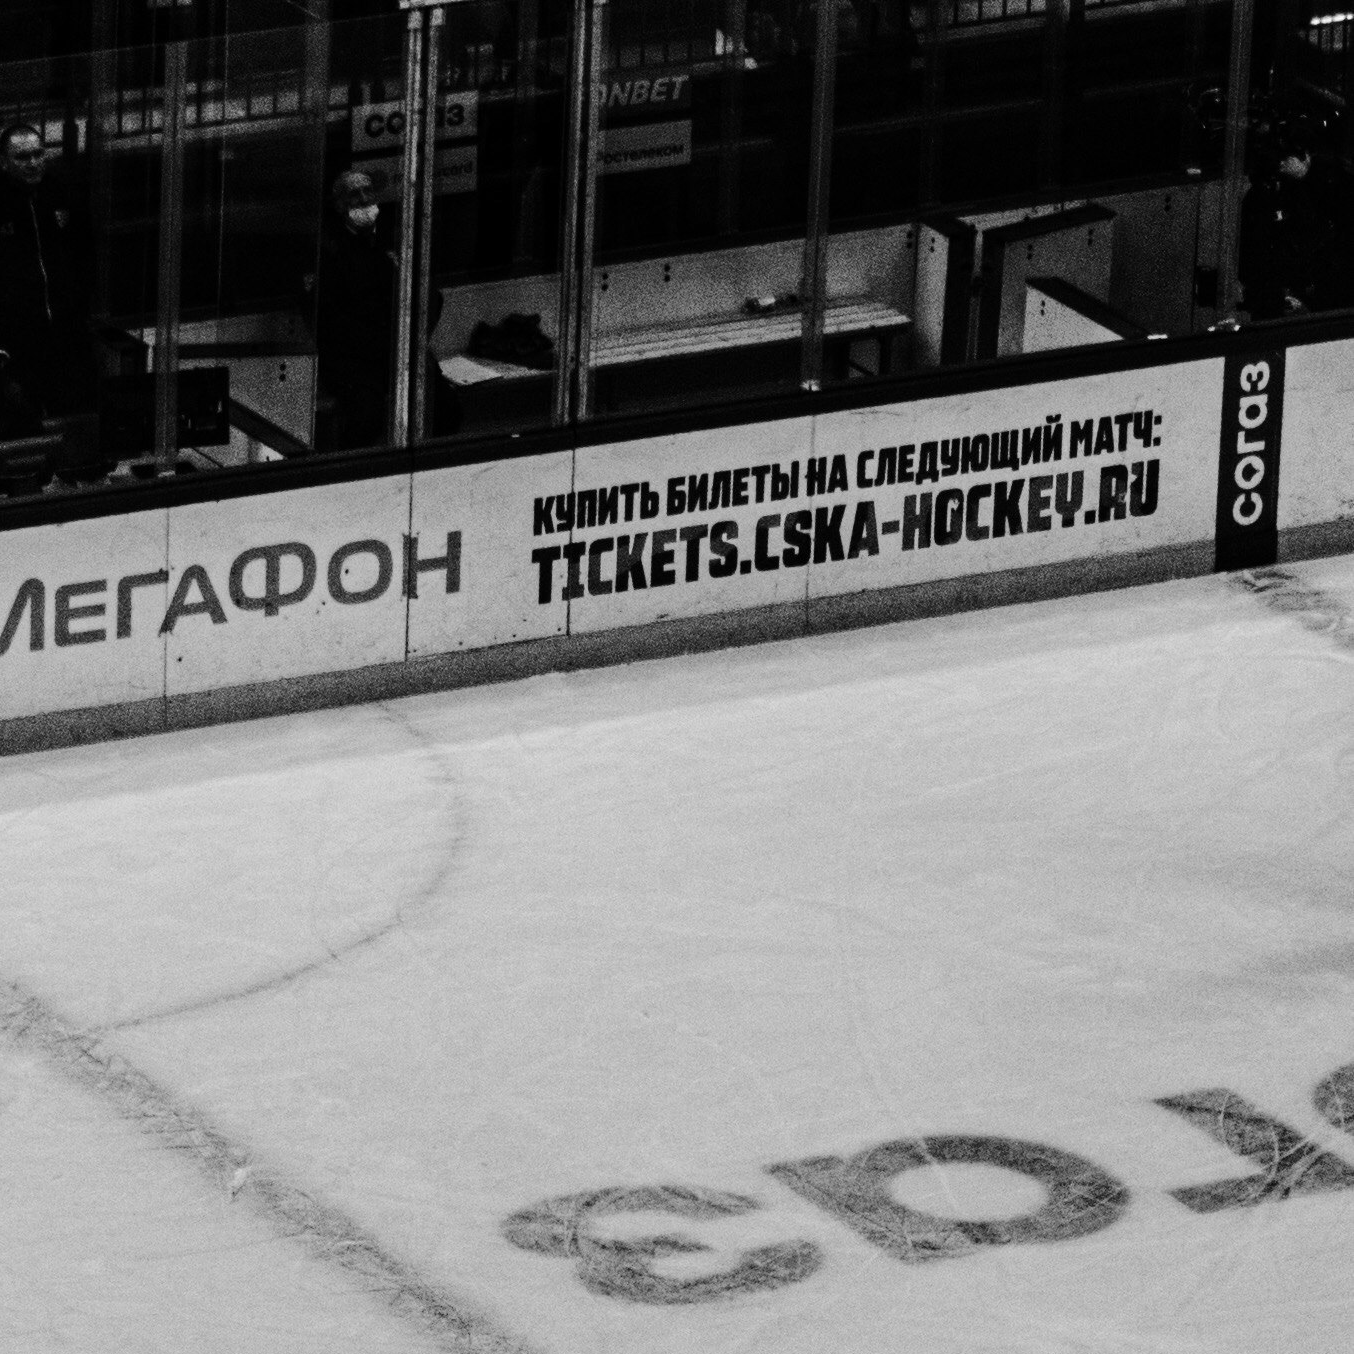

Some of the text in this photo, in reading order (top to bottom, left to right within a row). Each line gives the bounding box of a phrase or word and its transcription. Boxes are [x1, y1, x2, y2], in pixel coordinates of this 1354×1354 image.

[532, 410, 1163, 536] КУПИТЬ БИЛЕТЫ НА СЛЕДУЮЩИЙ МАТЧ:
[532, 459, 1160, 604] TICKETS.CSKA-HOCKEY.RU
